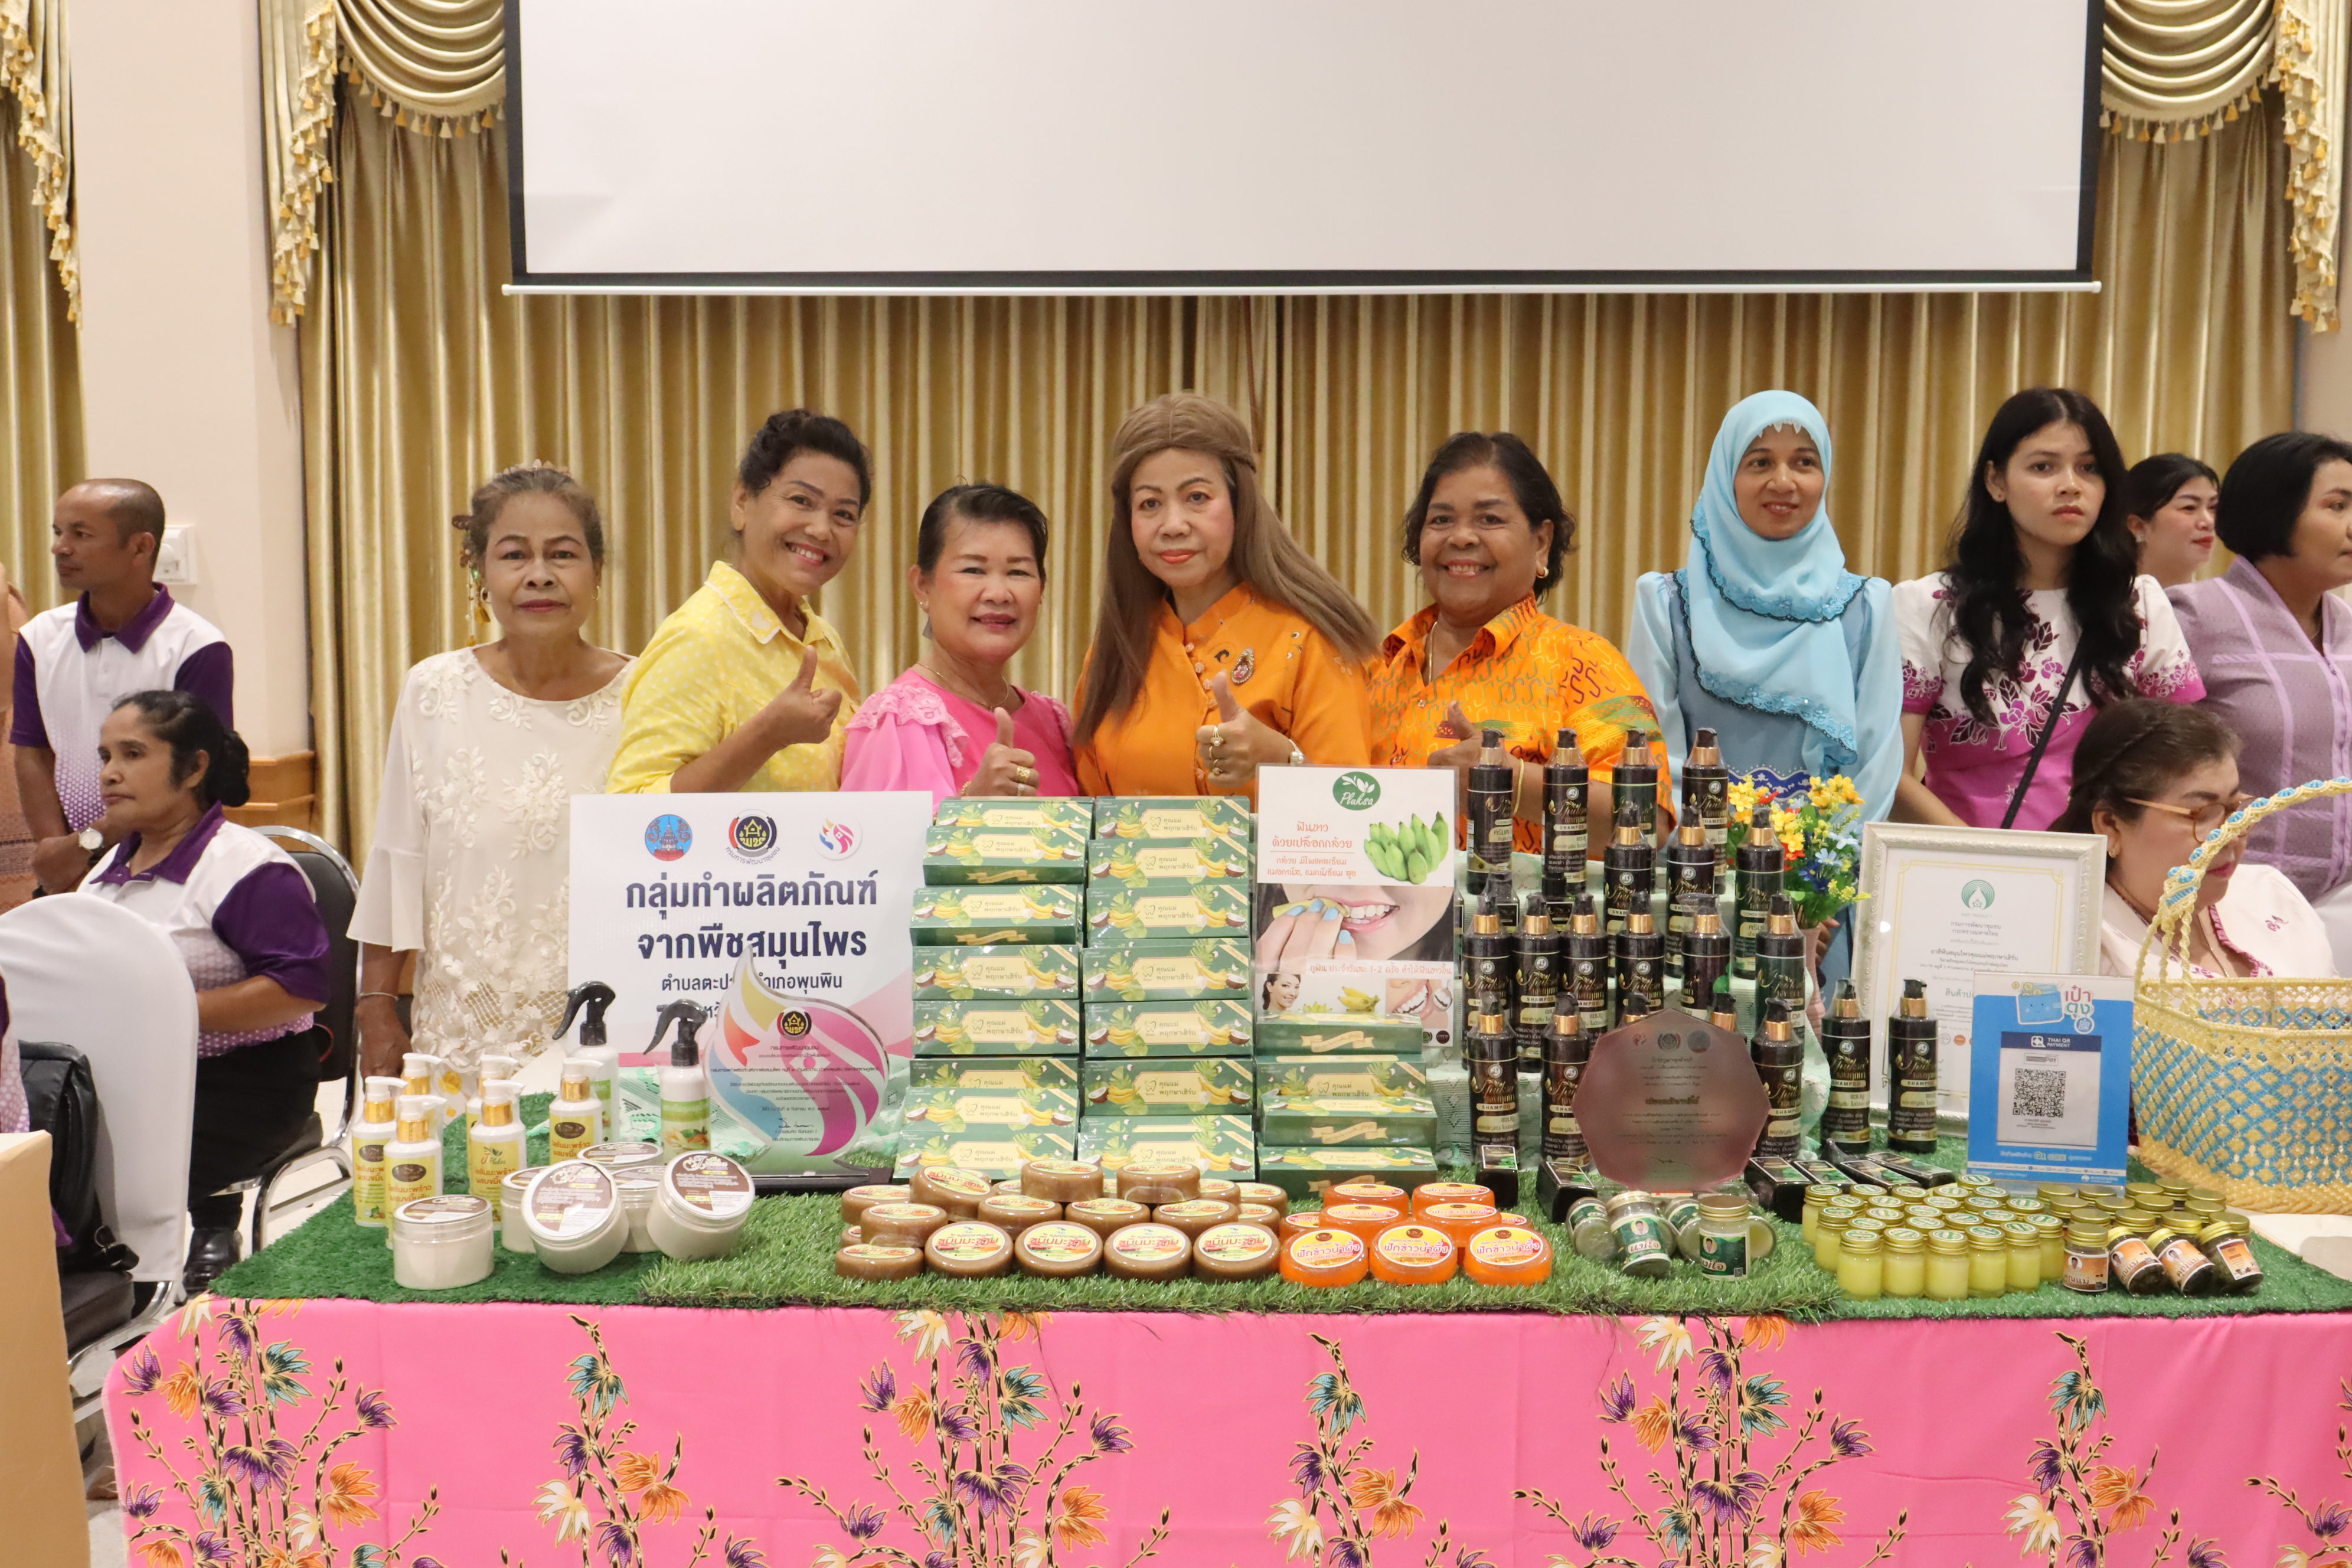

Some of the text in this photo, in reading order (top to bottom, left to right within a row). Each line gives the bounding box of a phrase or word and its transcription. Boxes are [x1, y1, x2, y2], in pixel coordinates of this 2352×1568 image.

[1340, 791, 1374, 806] Pluksa
[1164, 816, 1182, 825] คุณแม่
[1164, 824, 1198, 832] พฤกษาเฮิร์บ
[1296, 821, 1328, 832] ฟันขาว
[1272, 835, 1353, 848] ด้วยเปลือกกล้วย
[995, 845, 1031, 854] พฤกษาเฮิร์บ
[725, 846, 780, 865] กรมการพัฒนาชุมชน
[1158, 855, 1178, 864] คุณแม่
[1276, 855, 1296, 864] กล้วย
[1158, 863, 1194, 871] พฤกษาเฮิร์บ
[1346, 869, 1356, 879] สูง
[626, 870, 878, 920] กลุ่มทำผลิตภัณฑ์
[984, 899, 1003, 907] คุณแม่
[984, 904, 1020, 913] พฤกษาเฮิร์บ
[1158, 904, 1177, 913] คุณแม่
[1158, 912, 1194, 920] พฤกษาเฮิร์บ
[638, 921, 867, 969] จากพืชสมุนไพร
[985, 964, 1005, 974] คุณแม่
[1157, 965, 1176, 974] คุณแม่
[1386, 962, 1399, 974] ครั้ง
[985, 972, 1022, 982] พฤกษาเฮิร์บ
[1157, 972, 1194, 982] พฤกษาเฮิร์บ
[759, 973, 842, 997] ำเภอพุนพิน
[986, 1018, 1007, 1028] คุณแม่
[1159, 1020, 1179, 1029] คุณแม่
[986, 1026, 1024, 1036] พฤกษาเฮิร์บ
[1159, 1028, 1197, 1037] พฤกษาเฮิร์บ
[982, 1079, 1004, 1087] คุณแม่
[1159, 1080, 1179, 1089] คุณแม่
[1332, 1082, 1352, 1090] คุณแม่
[1158, 1087, 1197, 1097] พฤกษาเฮิร์บ
[551, 1139, 590, 1149] โลชั่นมะพร้าว
[1156, 1149, 1177, 1157] คุณแม่
[475, 1167, 515, 1177] โลชั่นมะพร้าว
[388, 1183, 432, 1194] โลชั่นมะพร้าว
[938, 1233, 999, 1245] ขมิ้นมะขาม
[1030, 1233, 1090, 1246] ขมิ้นมะขาม
[1119, 1235, 1178, 1246] ขมิ้นมะขาม
[1204, 1234, 1265, 1246] ขมิ้นมะขาม
[1297, 1240, 1360, 1259] ฟักข้าวน้ำผึ้ง
[1384, 1240, 1448, 1253] ฟักข้าวน้ำผึ้ง
[1476, 1240, 1540, 1255] ฟักข้าวน้ำผึ้ง
[2177, 1256, 2200, 1278] คุณแม่
